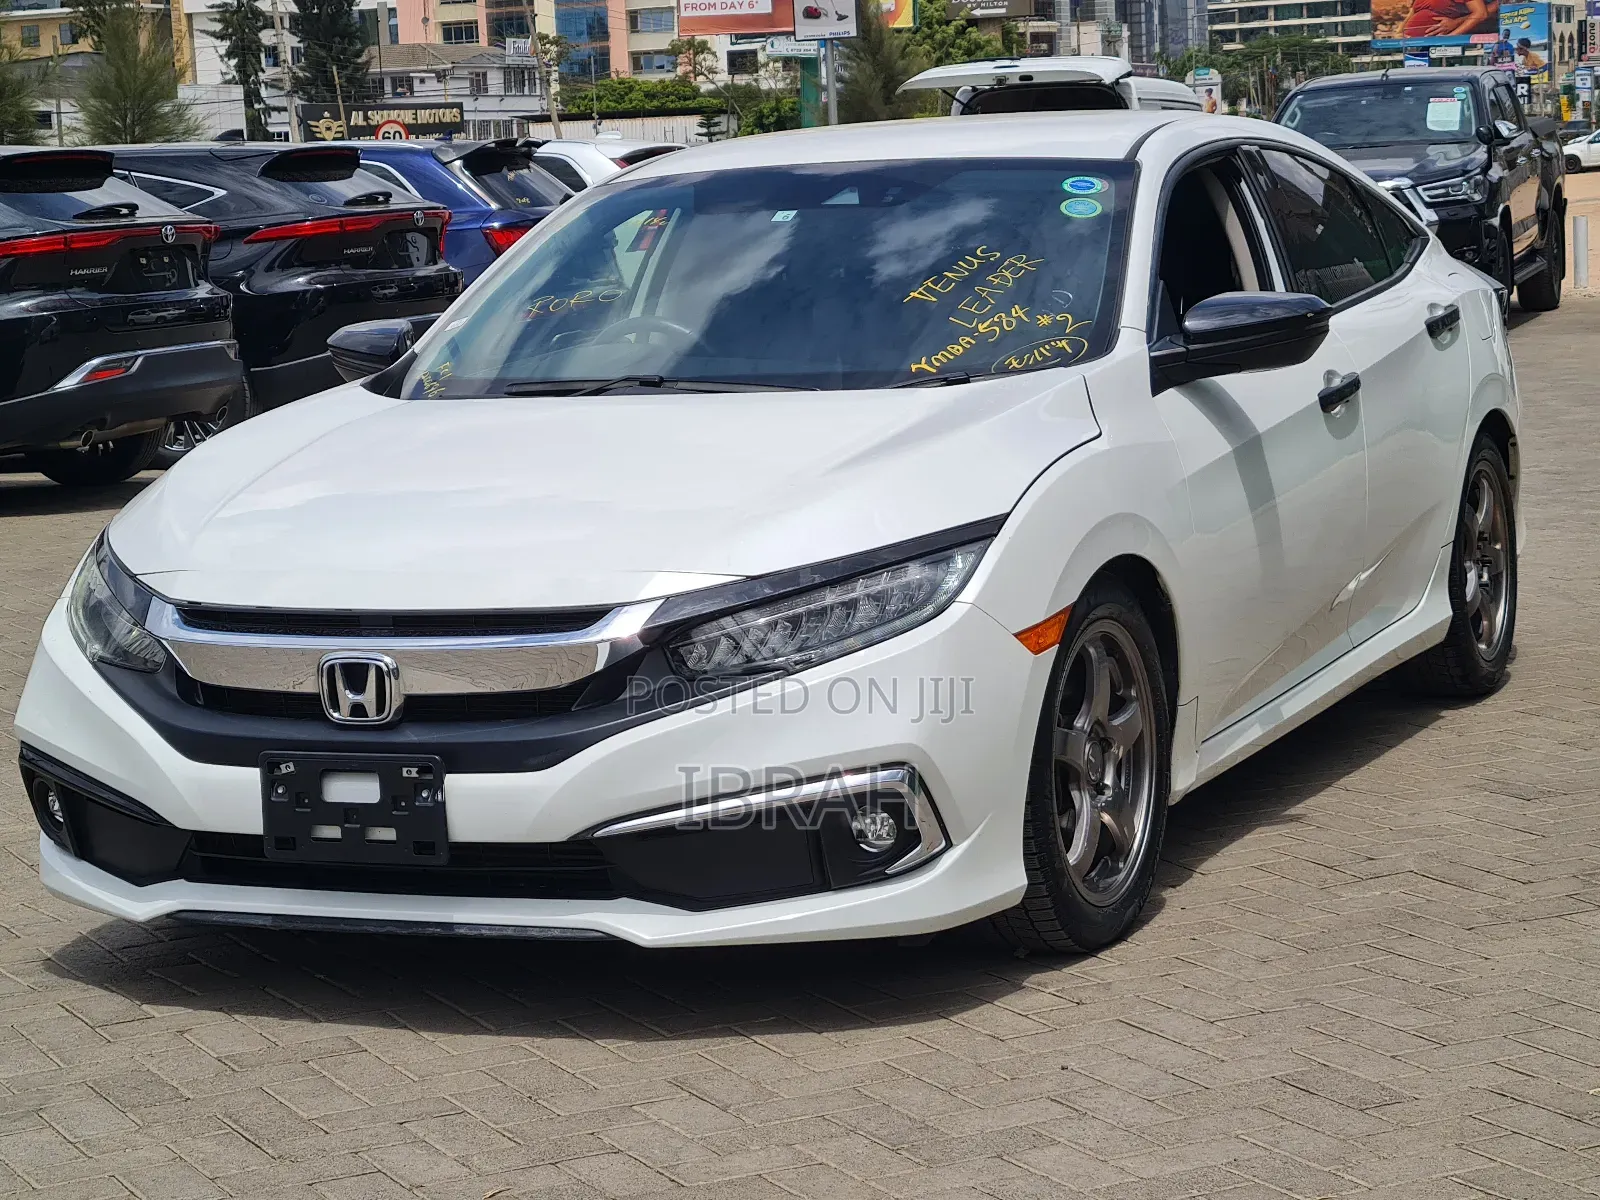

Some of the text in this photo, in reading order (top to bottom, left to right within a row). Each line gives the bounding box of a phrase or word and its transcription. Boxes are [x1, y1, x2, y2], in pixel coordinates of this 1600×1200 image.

[684, 1, 717, 12] FROM
[720, 0, 744, 11] DAY
[350, 110, 367, 126] AL
[417, 107, 461, 124] MOTORS
[70, 266, 108, 276] HARRIER
[902, 245, 1000, 302] VENUS
[948, 254, 1045, 328] LEADER
